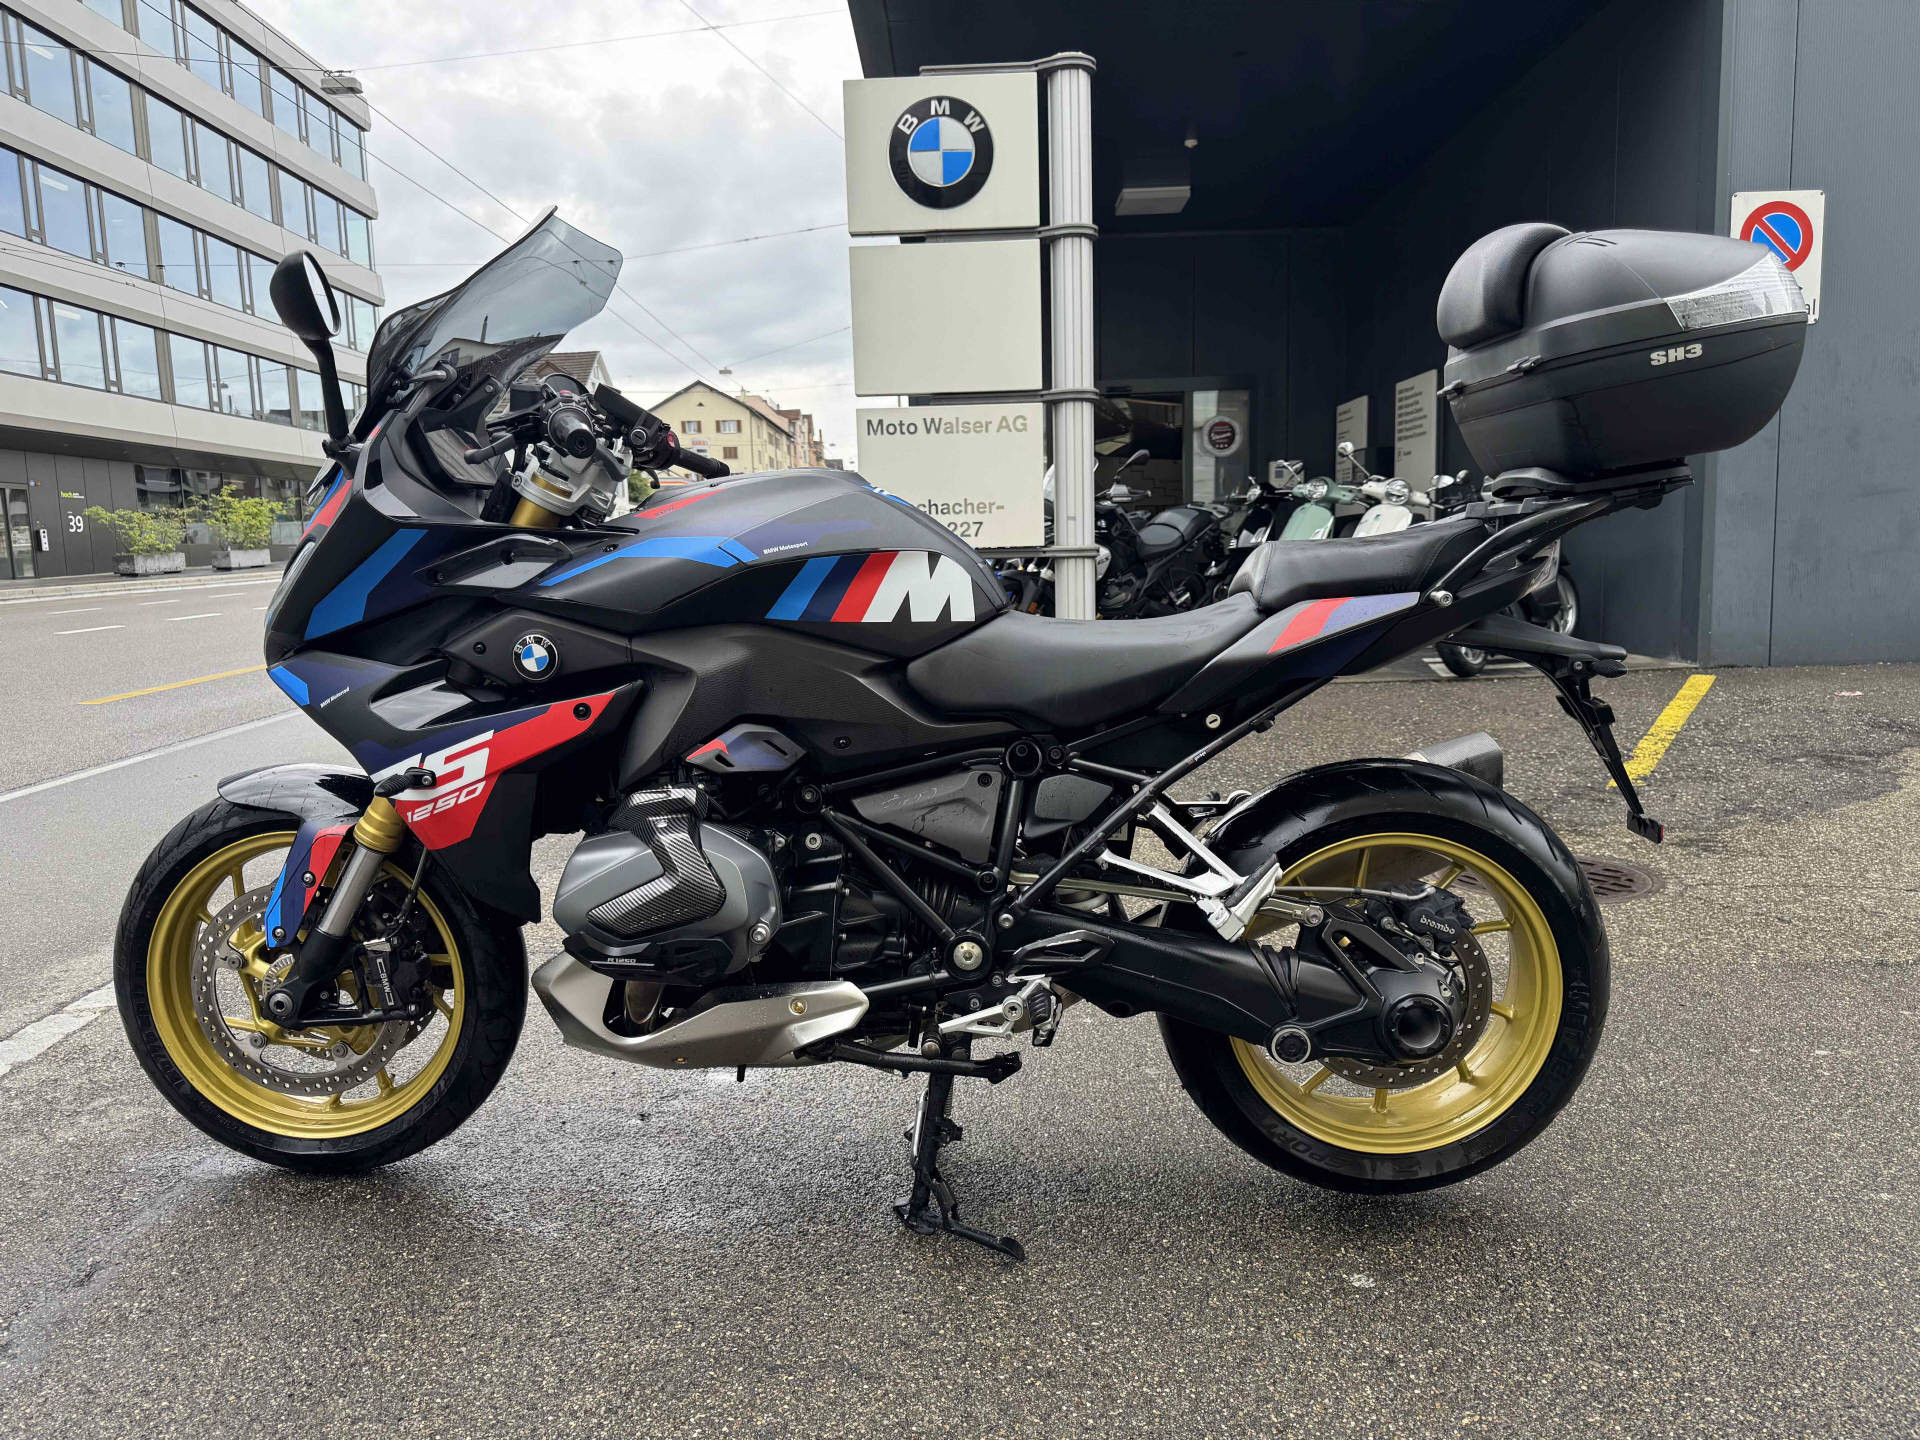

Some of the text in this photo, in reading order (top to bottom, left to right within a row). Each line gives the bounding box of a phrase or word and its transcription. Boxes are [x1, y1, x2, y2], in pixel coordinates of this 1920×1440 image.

[897, 99, 985, 135] BMW
[1650, 343, 1703, 366] SH3
[866, 414, 1028, 436] Moto Walser AG
[917, 498, 1005, 516] chacher-
[67, 515, 84, 533] 39
[947, 521, 984, 538] 227
[861, 551, 976, 623] M
[514, 635, 551, 654] BMW
[406, 781, 487, 823] 1250
[1420, 914, 1456, 935] brembo
[380, 973, 391, 993] BMW
